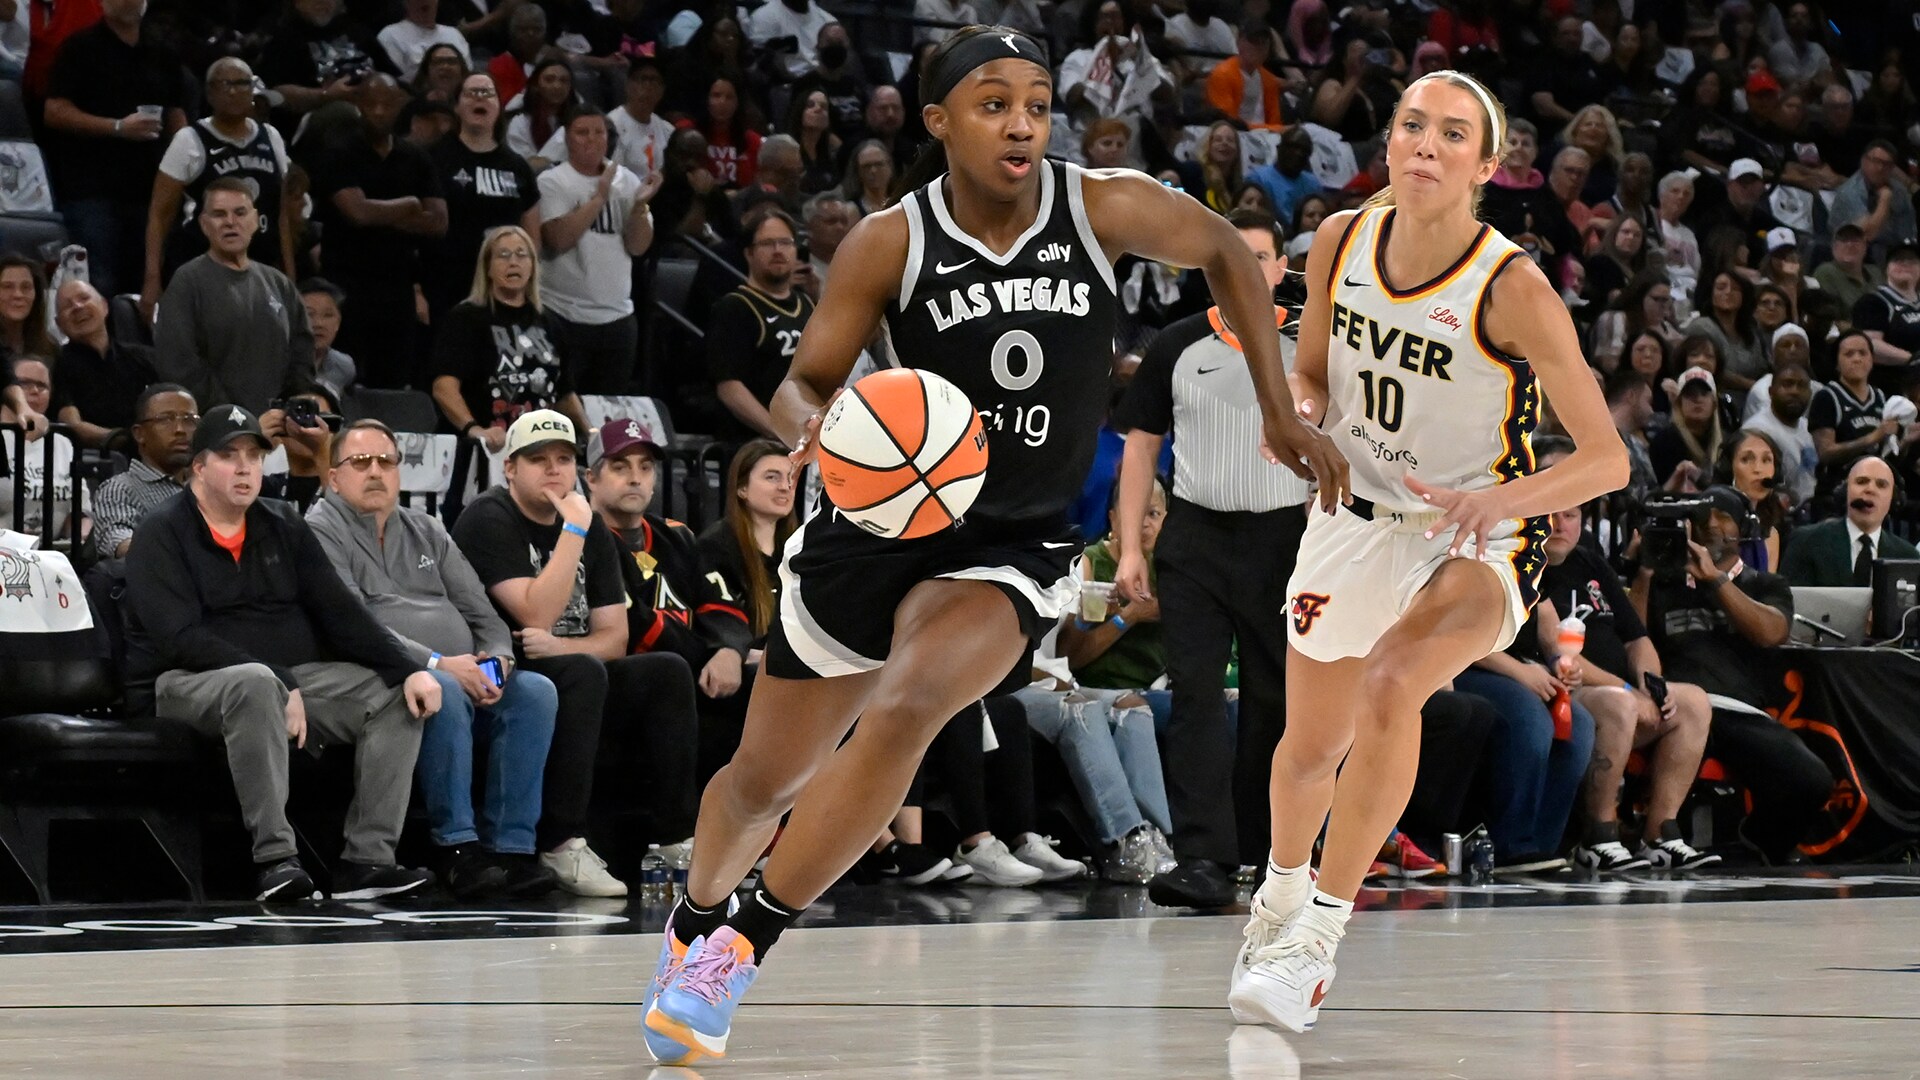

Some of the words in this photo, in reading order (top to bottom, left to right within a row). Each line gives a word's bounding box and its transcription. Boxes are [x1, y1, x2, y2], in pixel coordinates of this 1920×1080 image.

[1037, 242, 1072, 263] ally
[926, 282, 992, 333] LAS
[991, 276, 1091, 317] VEGAS
[1428, 306, 1463, 332] Lilly
[990, 329, 1044, 391] 0
[1331, 301, 1455, 383] FEVER
[530, 420, 570, 433] ACES
[1358, 369, 1405, 433] 10
